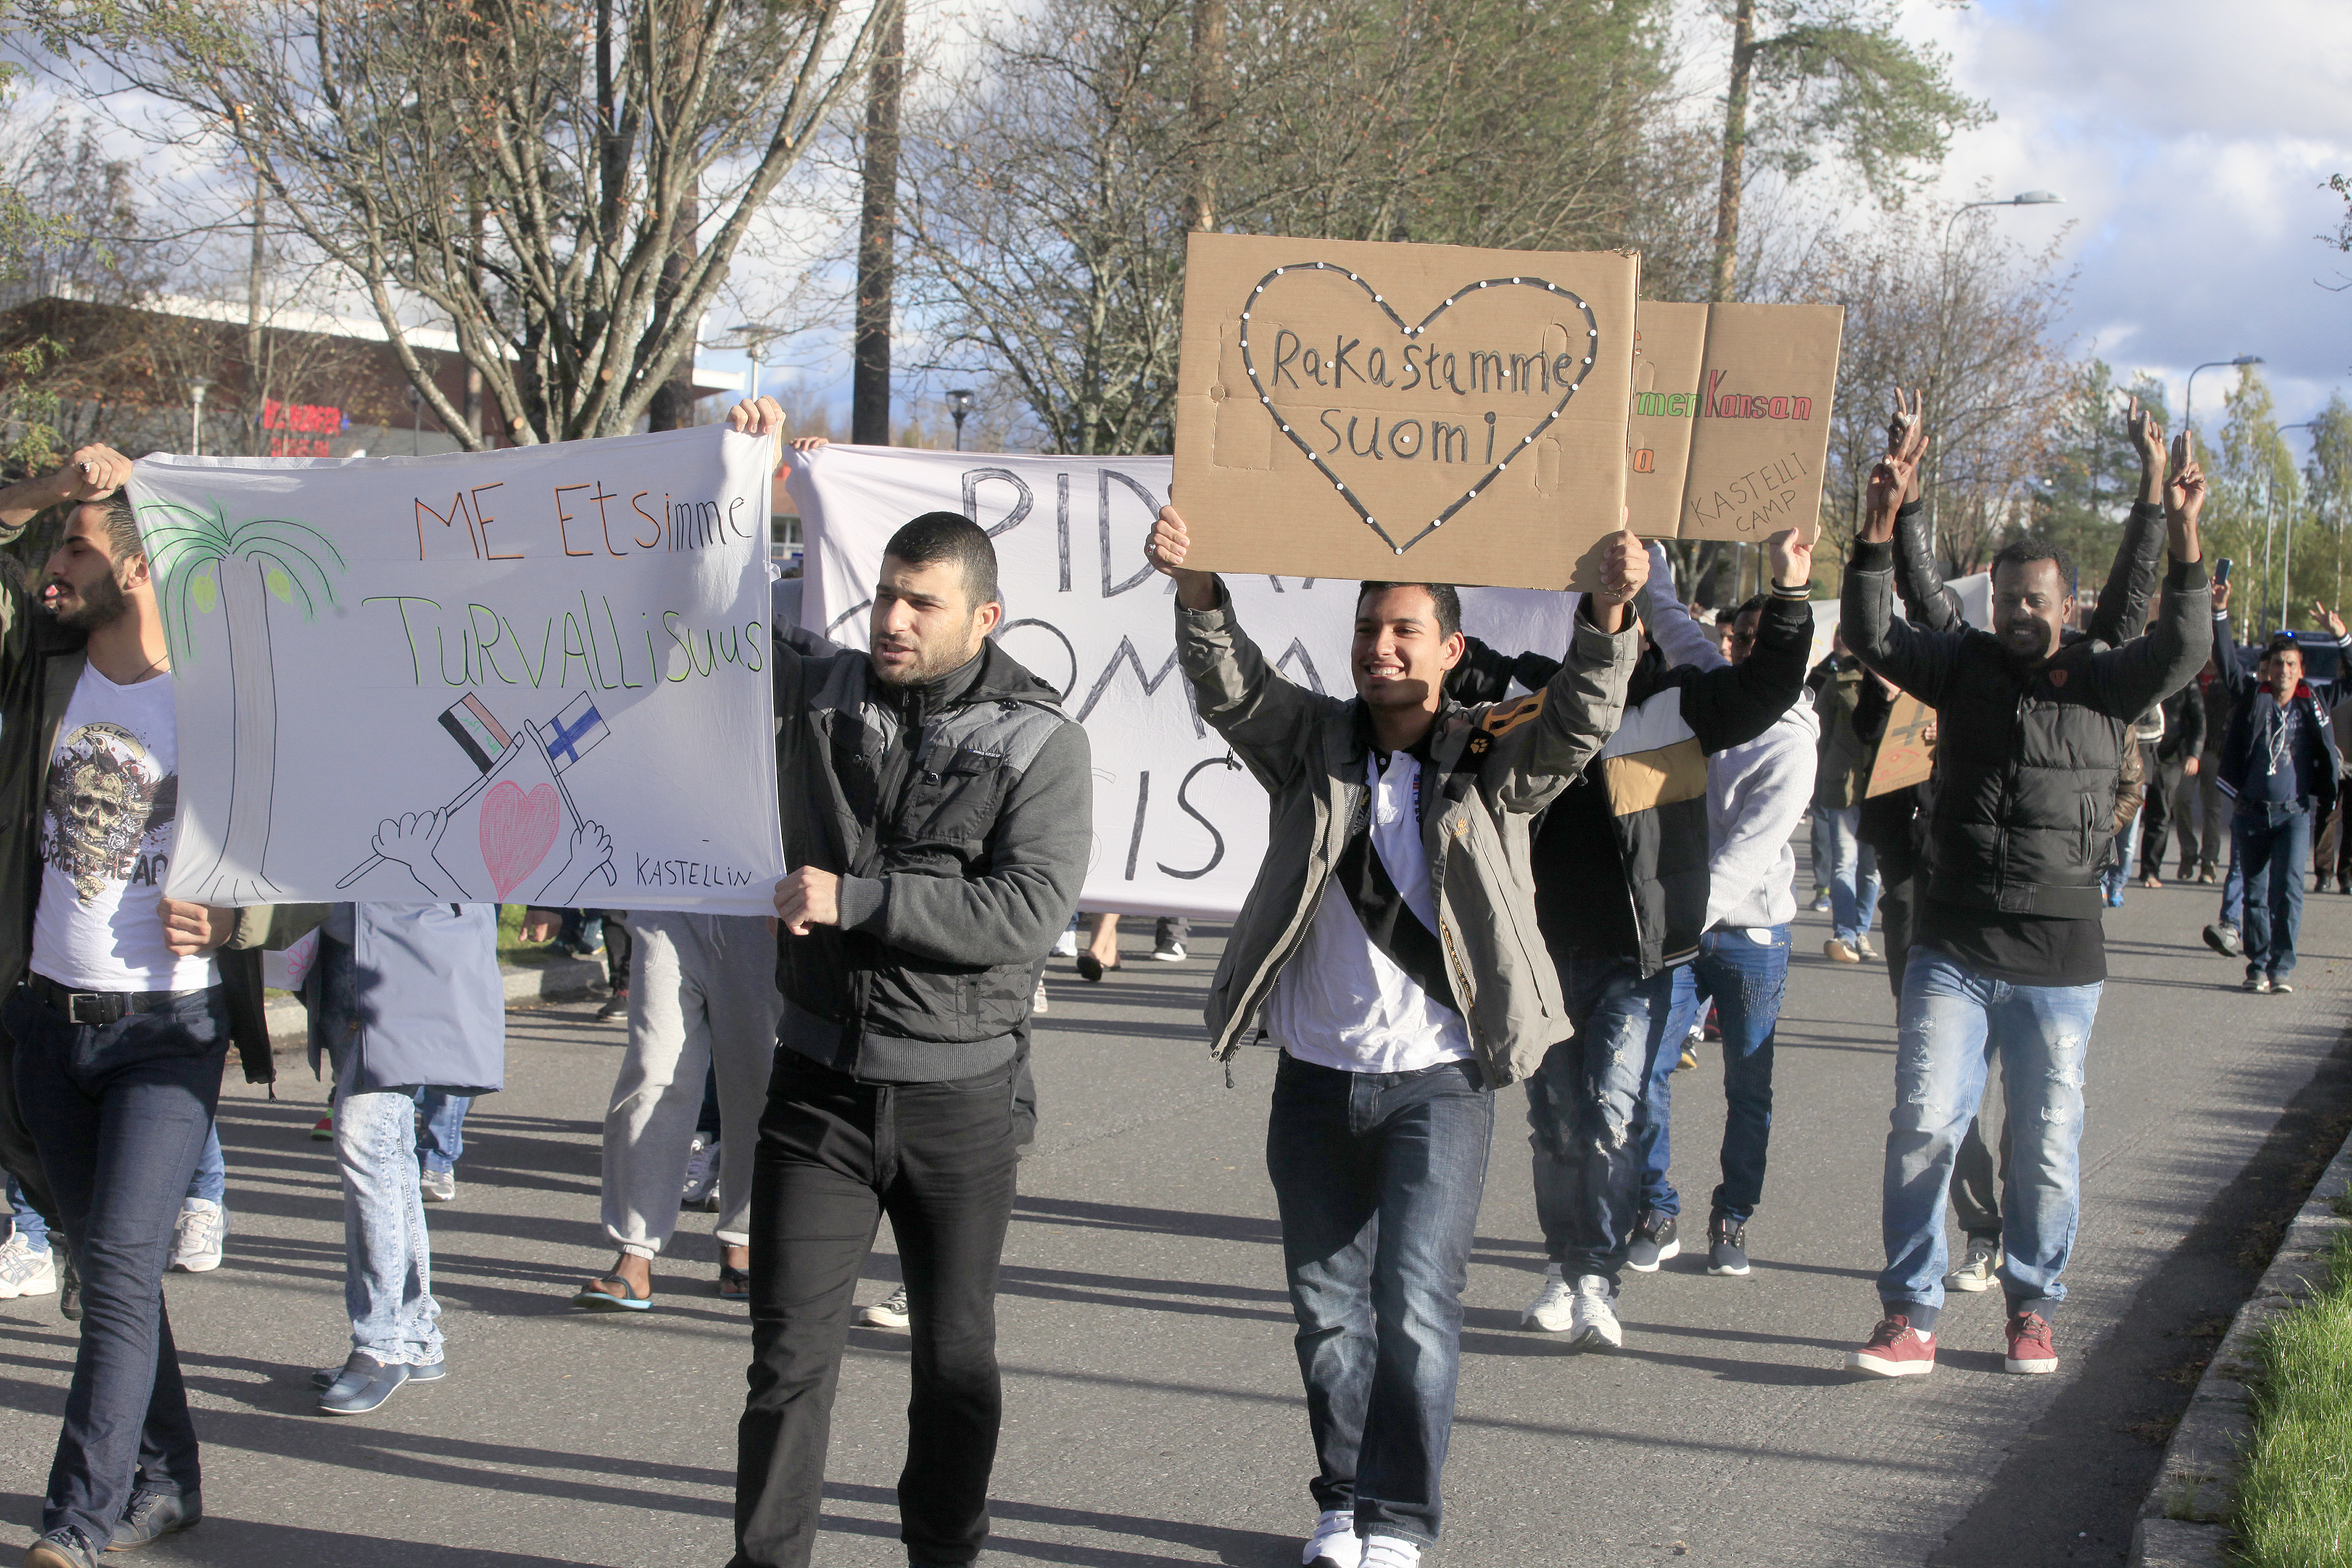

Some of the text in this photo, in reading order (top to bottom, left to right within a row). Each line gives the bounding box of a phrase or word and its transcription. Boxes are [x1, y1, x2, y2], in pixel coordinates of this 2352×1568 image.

[1632, 369, 1812, 421] men Kansan
[1628, 448, 1655, 474] a
[1690, 452, 1807, 527] KASTELLI
[1736, 489, 1796, 532] CAMP
[415, 482, 525, 560] ME
[81, 725, 133, 740] JULIE
[1453, 827, 1469, 838] skin
